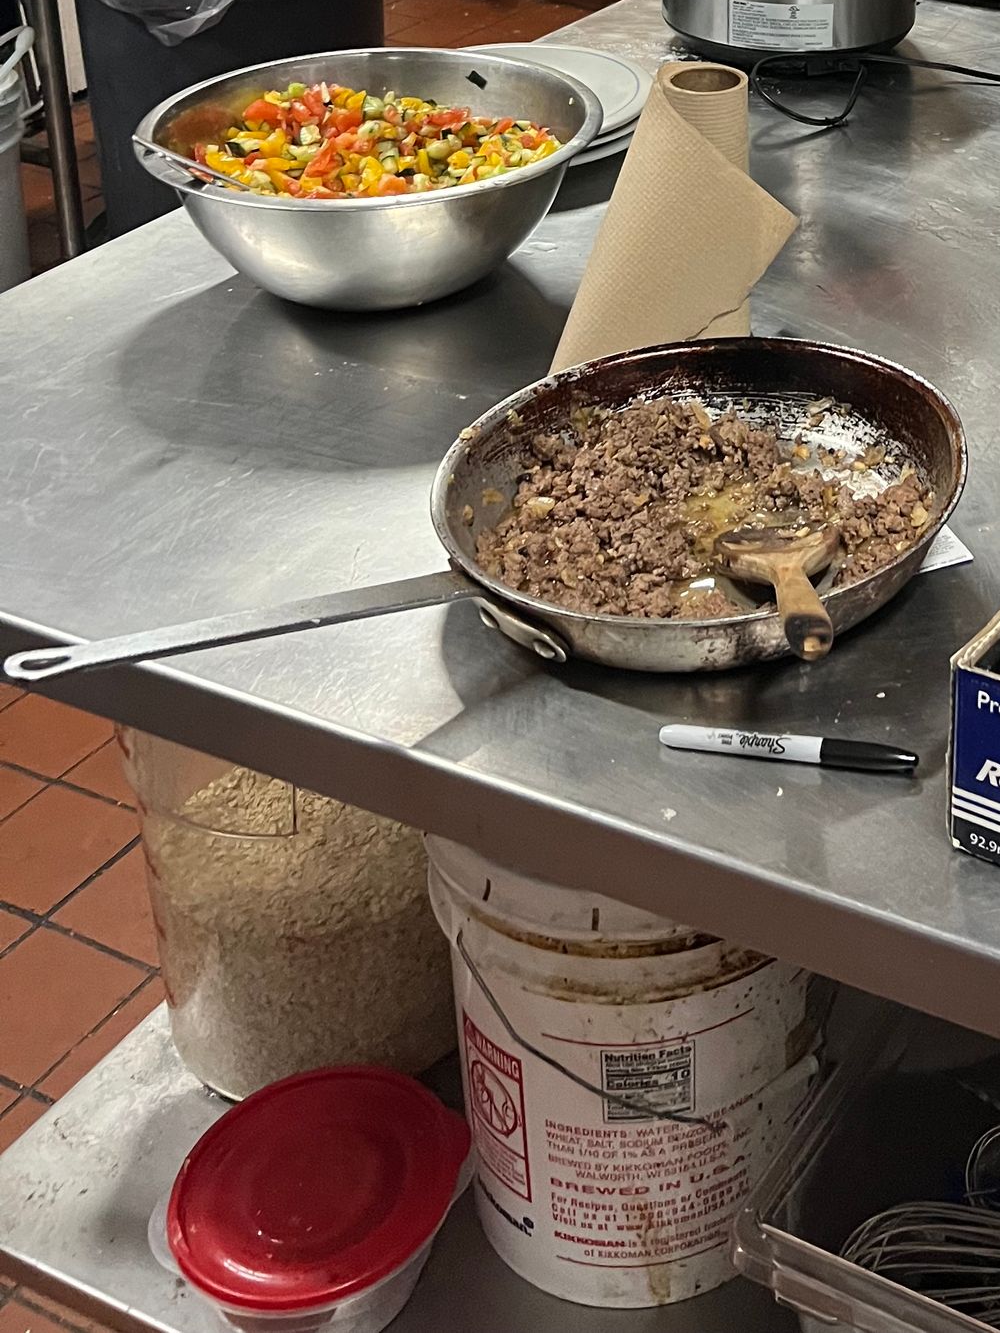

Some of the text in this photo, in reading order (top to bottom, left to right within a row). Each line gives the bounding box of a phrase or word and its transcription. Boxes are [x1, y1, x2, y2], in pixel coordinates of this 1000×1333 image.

[475, 1029, 520, 1079] WARNING
[604, 1053, 656, 1063] Nutrition
[659, 1045, 692, 1059] Facts
[671, 1069, 691, 1081] 10
[547, 1140, 575, 1155] THAN
[548, 1153, 592, 1170] BREWED
[594, 1163, 609, 1172] BY
[613, 1156, 684, 1172] KIKKOMAN
[550, 1177, 650, 1196] BREWED
[659, 1180, 681, 1192] IN
[551, 1192, 567, 1204] For
[621, 1198, 677, 1212] Questions
[680, 1193, 692, 1203] or
[551, 1203, 577, 1217] Call
[583, 1212, 597, 1221] us
[604, 1214, 617, 1222] at
[552, 1213, 577, 1227] Visit
[581, 1222, 593, 1230] us
[597, 1223, 609, 1231] at
[554, 1230, 626, 1247] KIKKOMAN
[628, 1239, 638, 1248] is
[584, 1249, 594, 1257] of
[598, 1250, 652, 1260] KIKKOMAN
